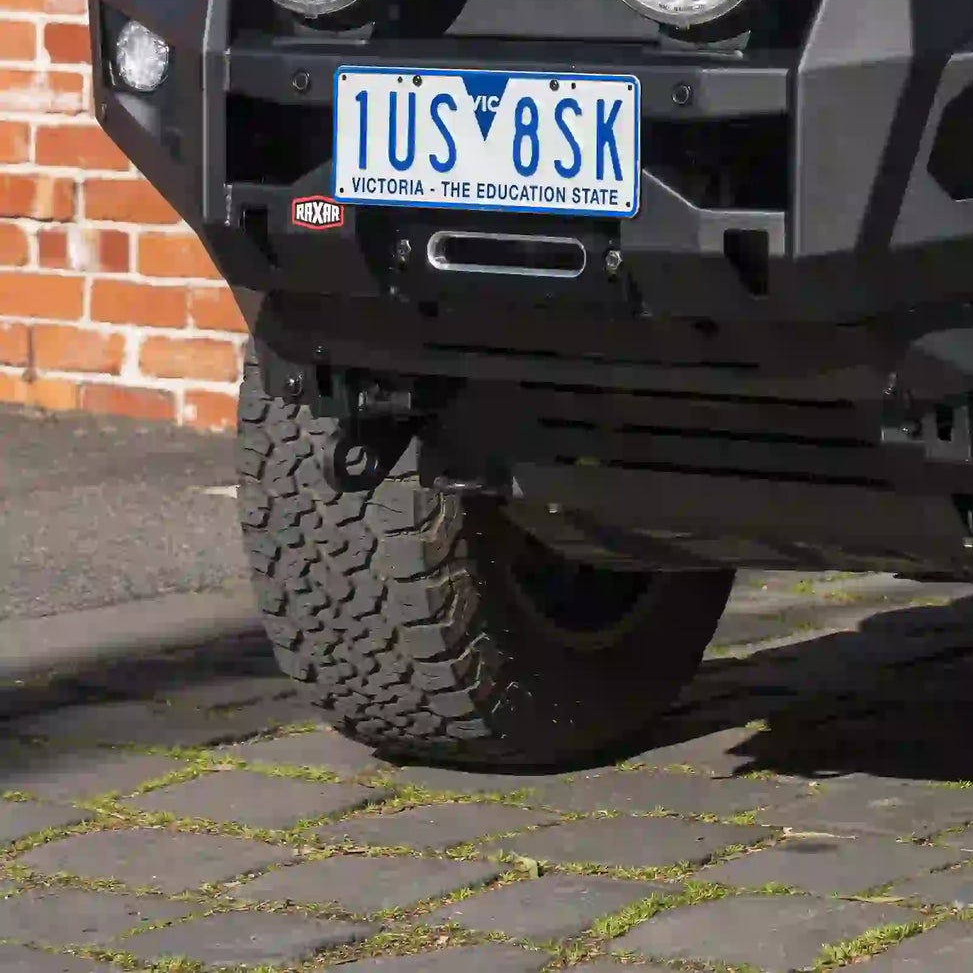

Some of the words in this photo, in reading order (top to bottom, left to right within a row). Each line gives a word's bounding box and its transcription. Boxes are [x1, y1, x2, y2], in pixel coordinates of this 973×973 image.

[471, 95, 500, 112] VIC
[355, 91, 457, 173] 1US
[512, 96, 623, 181] 8SK
[352, 177, 424, 195] VICTORIA
[441, 181, 470, 198] THE
[476, 183, 566, 203] EDUCATION
[571, 187, 618, 205] STATE
[296, 201, 340, 225] RAXAR
